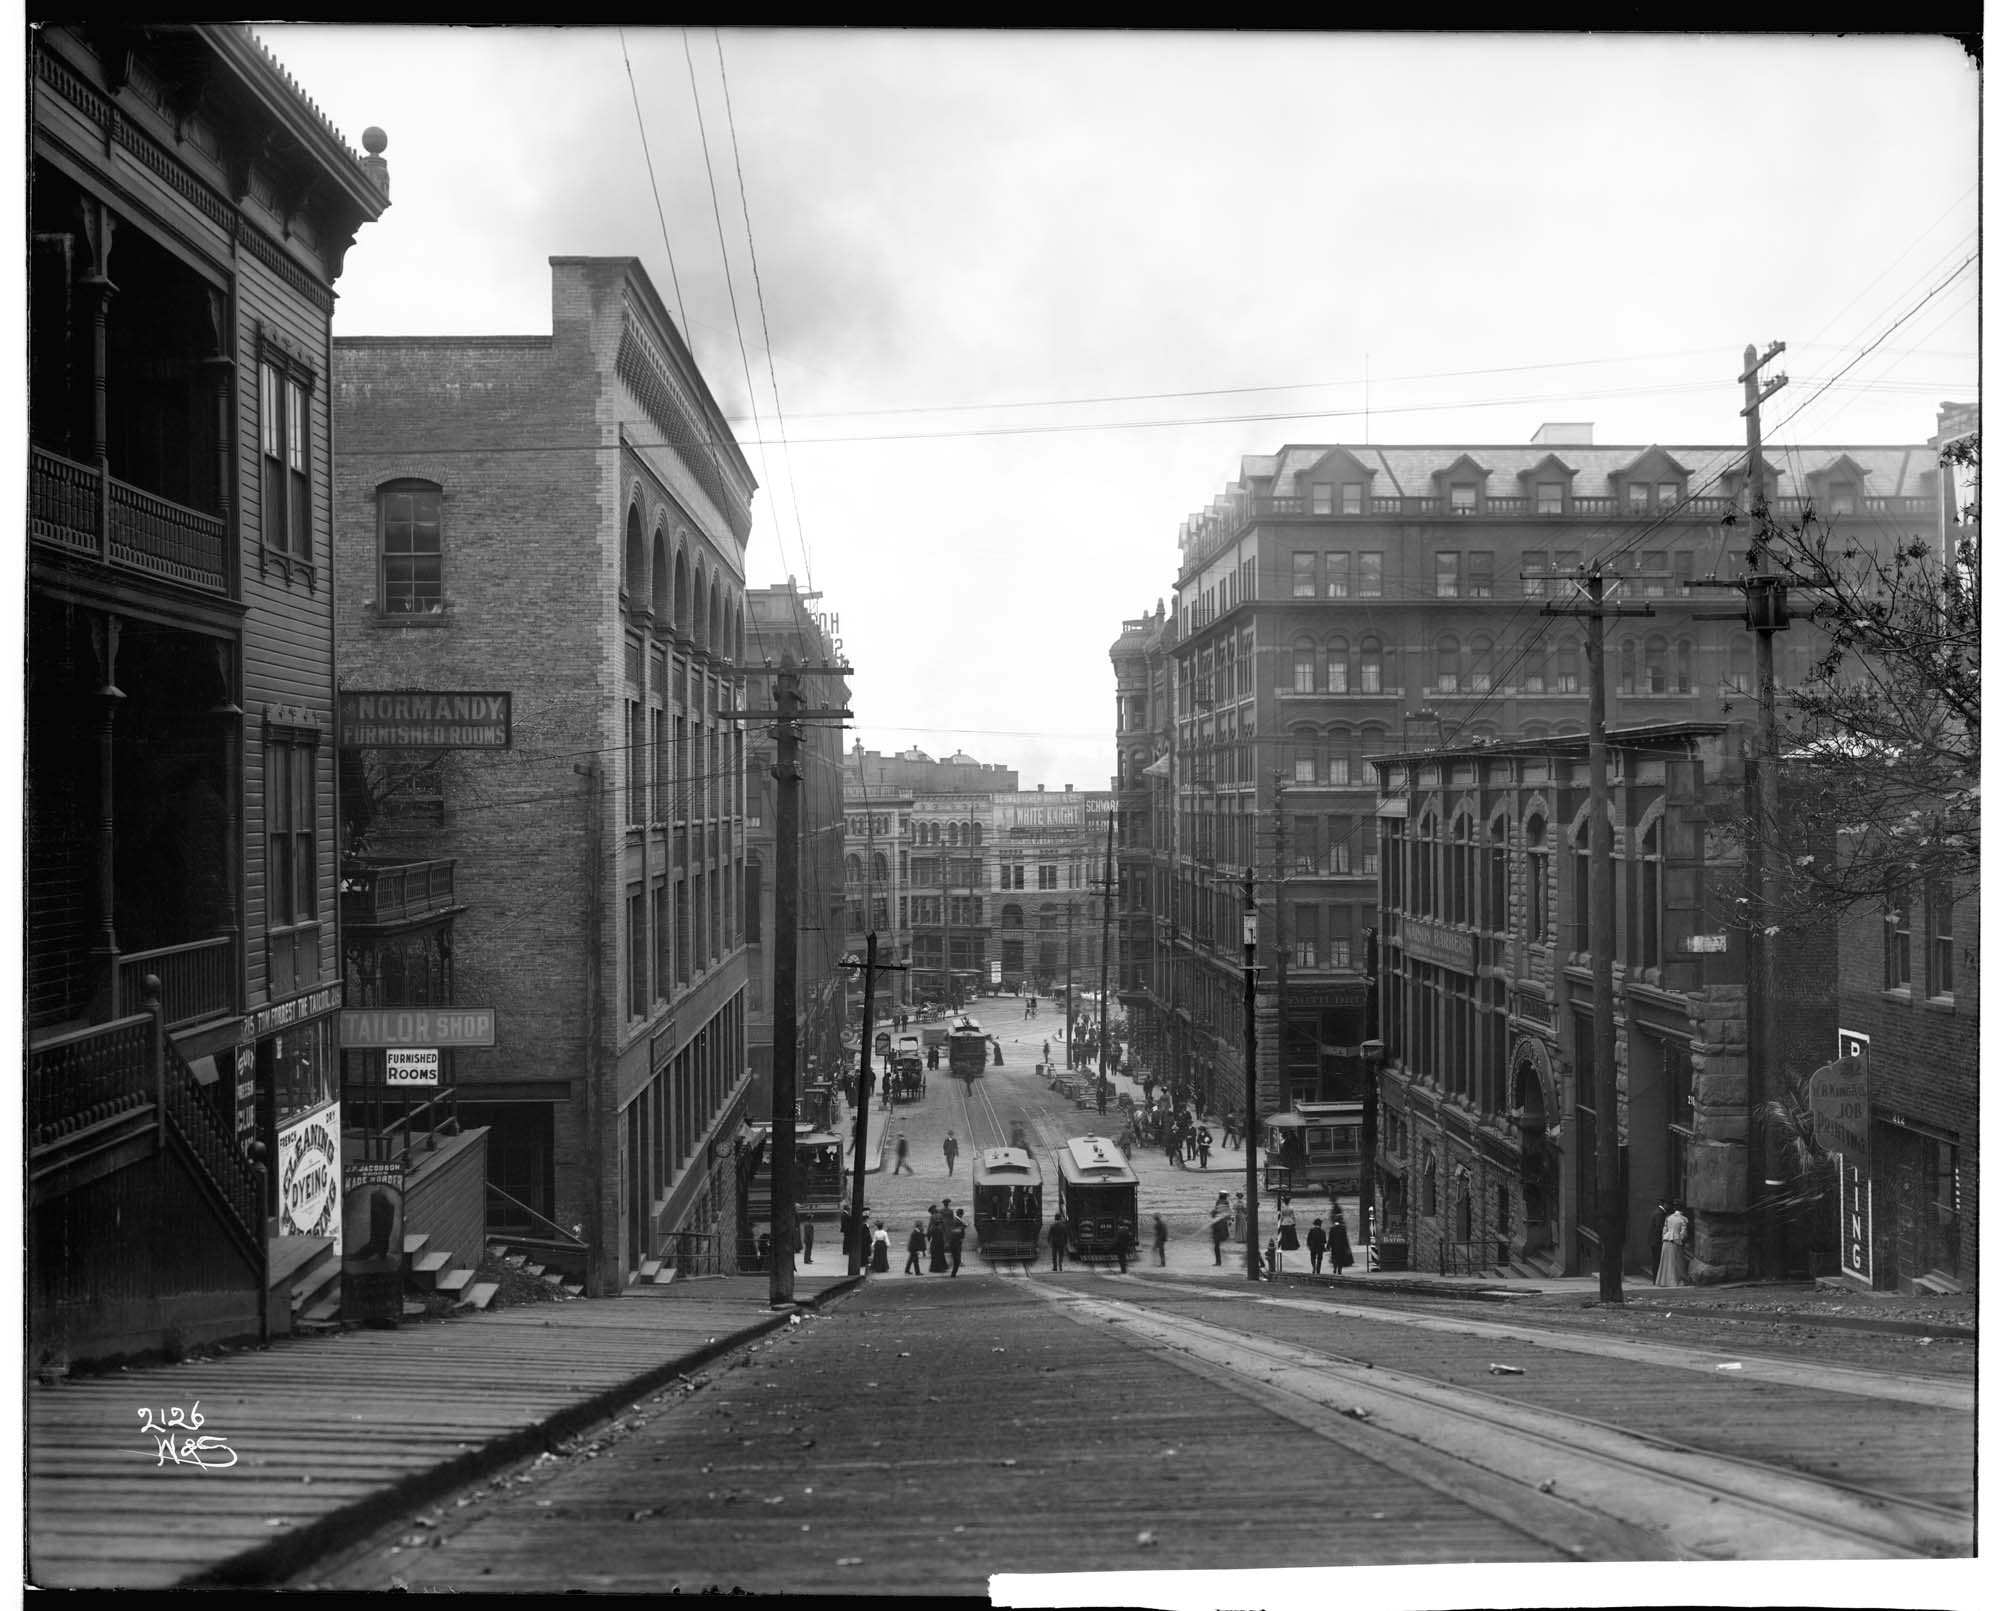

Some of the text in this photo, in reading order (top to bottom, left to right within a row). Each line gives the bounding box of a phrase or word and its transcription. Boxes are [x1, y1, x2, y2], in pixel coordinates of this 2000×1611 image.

[344, 725, 505, 745] FURNISHED ROOMS
[1017, 807, 1078, 825] WHITE KNIGHT
[297, 997, 308, 1019] THE
[345, 1013, 489, 1042] TAILOR SHOP
[388, 1053, 437, 1064] FURNISHED
[326, 1111, 335, 1123] DRY
[1837, 1103, 1862, 1119] JOB
[279, 1131, 297, 1149] FRENCH
[283, 1124, 335, 1201] CLEANING
[292, 1164, 328, 1209] DYEING
